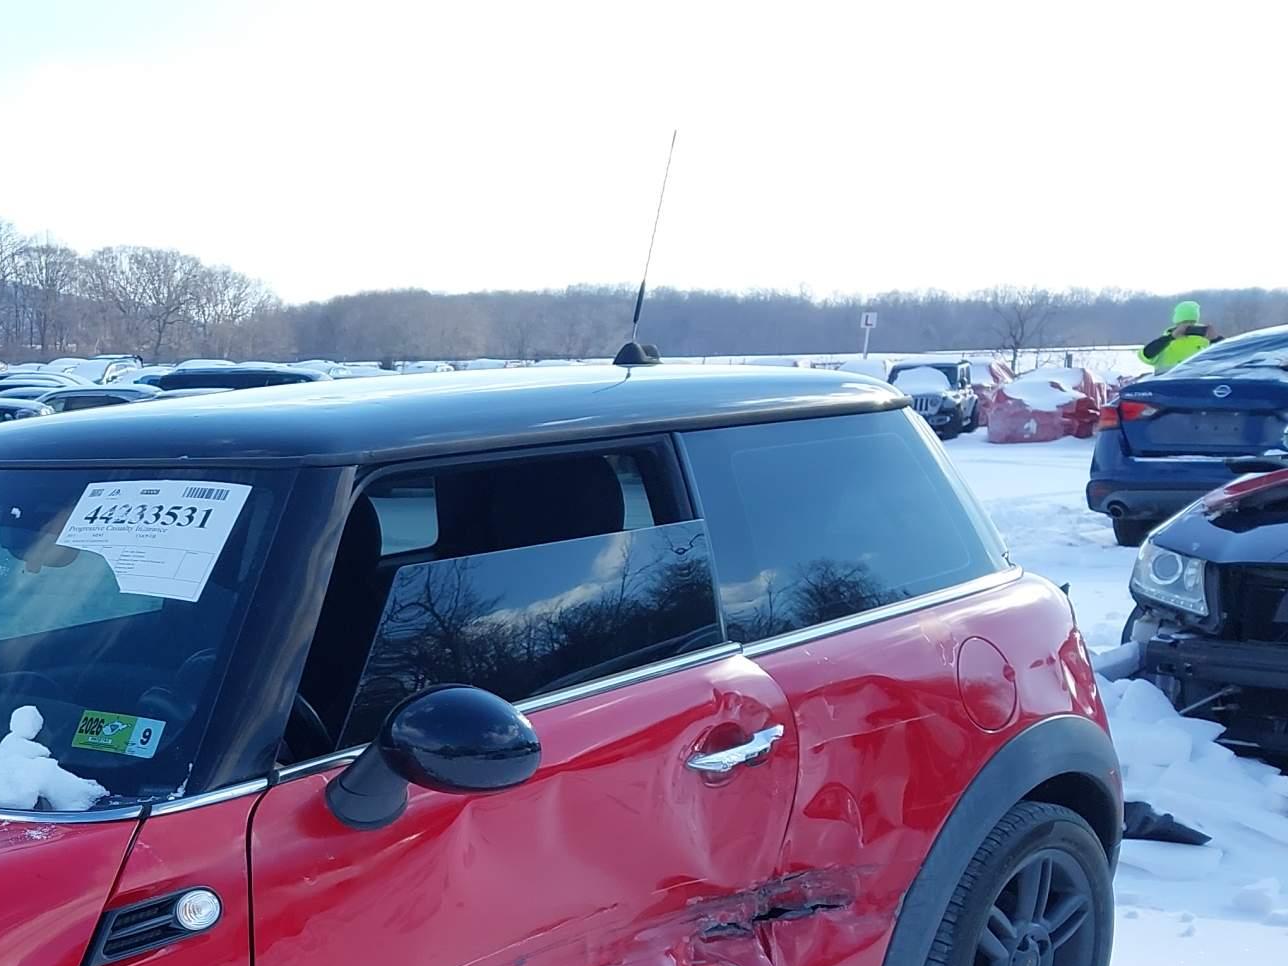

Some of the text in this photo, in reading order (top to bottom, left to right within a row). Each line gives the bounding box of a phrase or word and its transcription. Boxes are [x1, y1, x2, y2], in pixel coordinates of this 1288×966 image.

[864, 314, 873, 326] L
[84, 503, 214, 529] 44233531
[78, 716, 105, 736] 2026
[139, 727, 153, 746] 9
